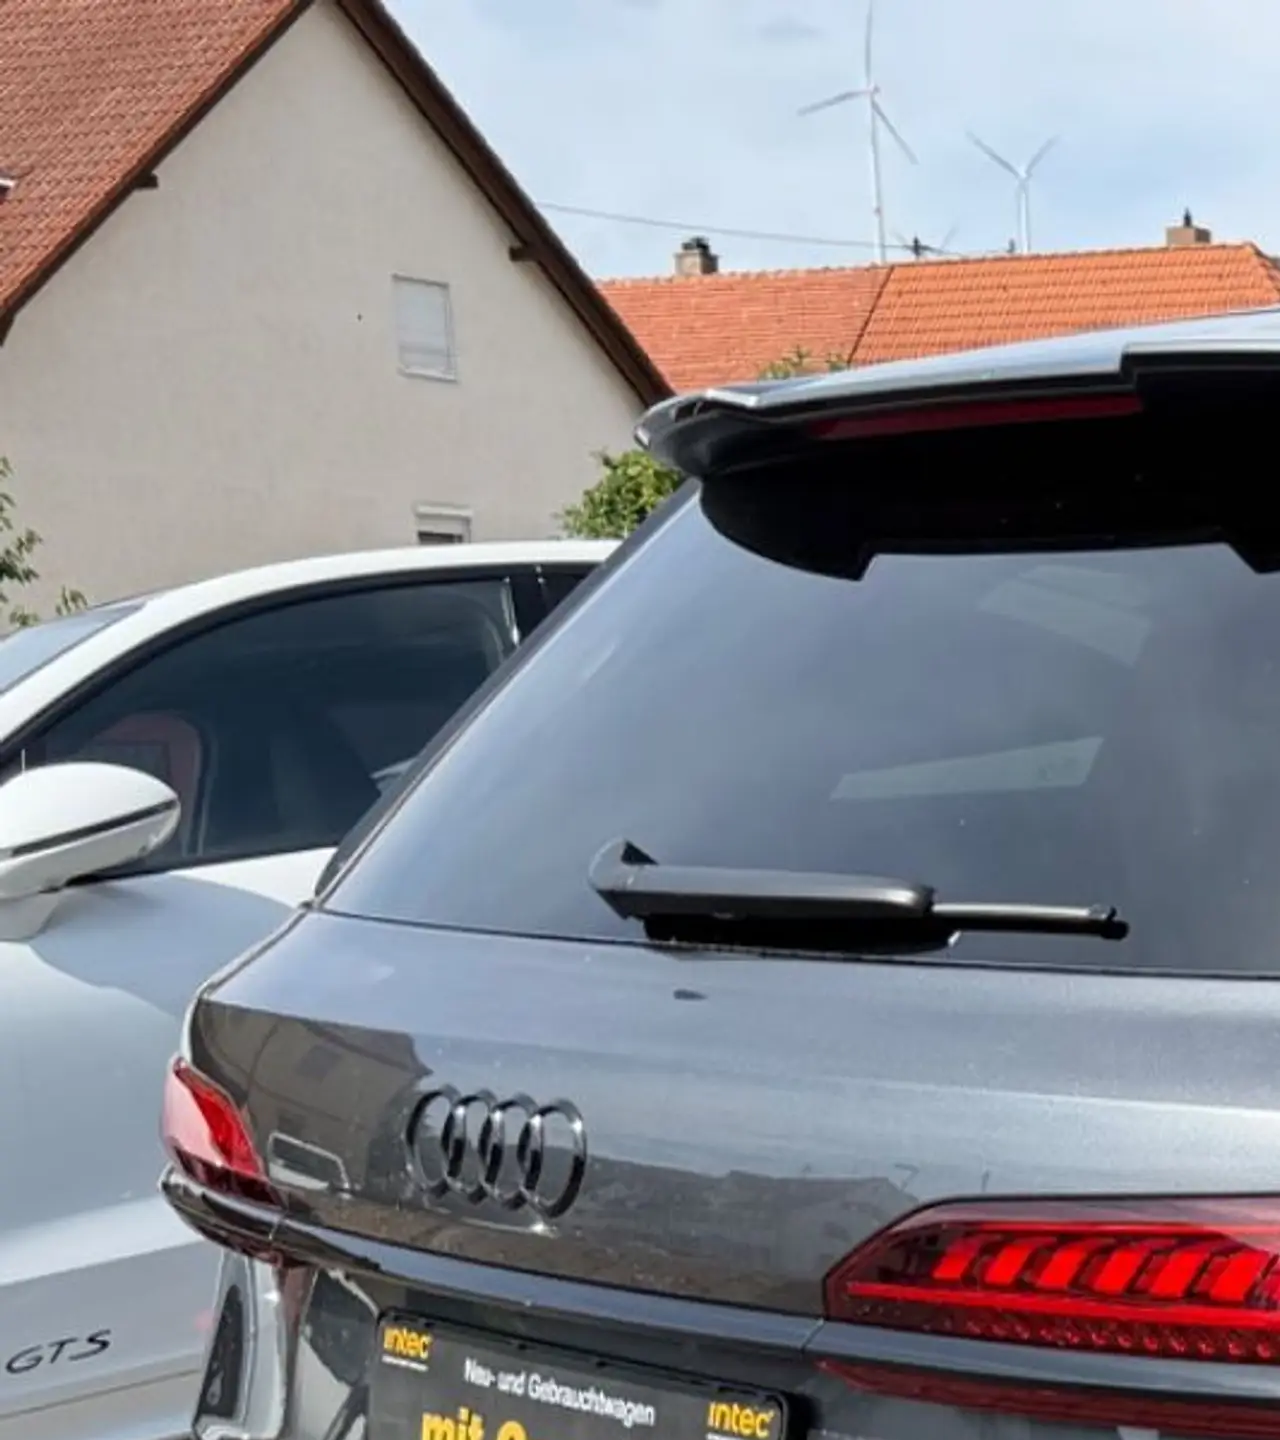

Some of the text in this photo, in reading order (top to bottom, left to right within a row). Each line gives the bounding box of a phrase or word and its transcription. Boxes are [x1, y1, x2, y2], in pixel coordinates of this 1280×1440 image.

[6, 1329, 111, 1374] GTS
[383, 1326, 433, 1360] intec
[498, 1370, 527, 1396] und
[528, 1373, 655, 1429] Gebrauchtwagen
[706, 1401, 774, 1440] intec
